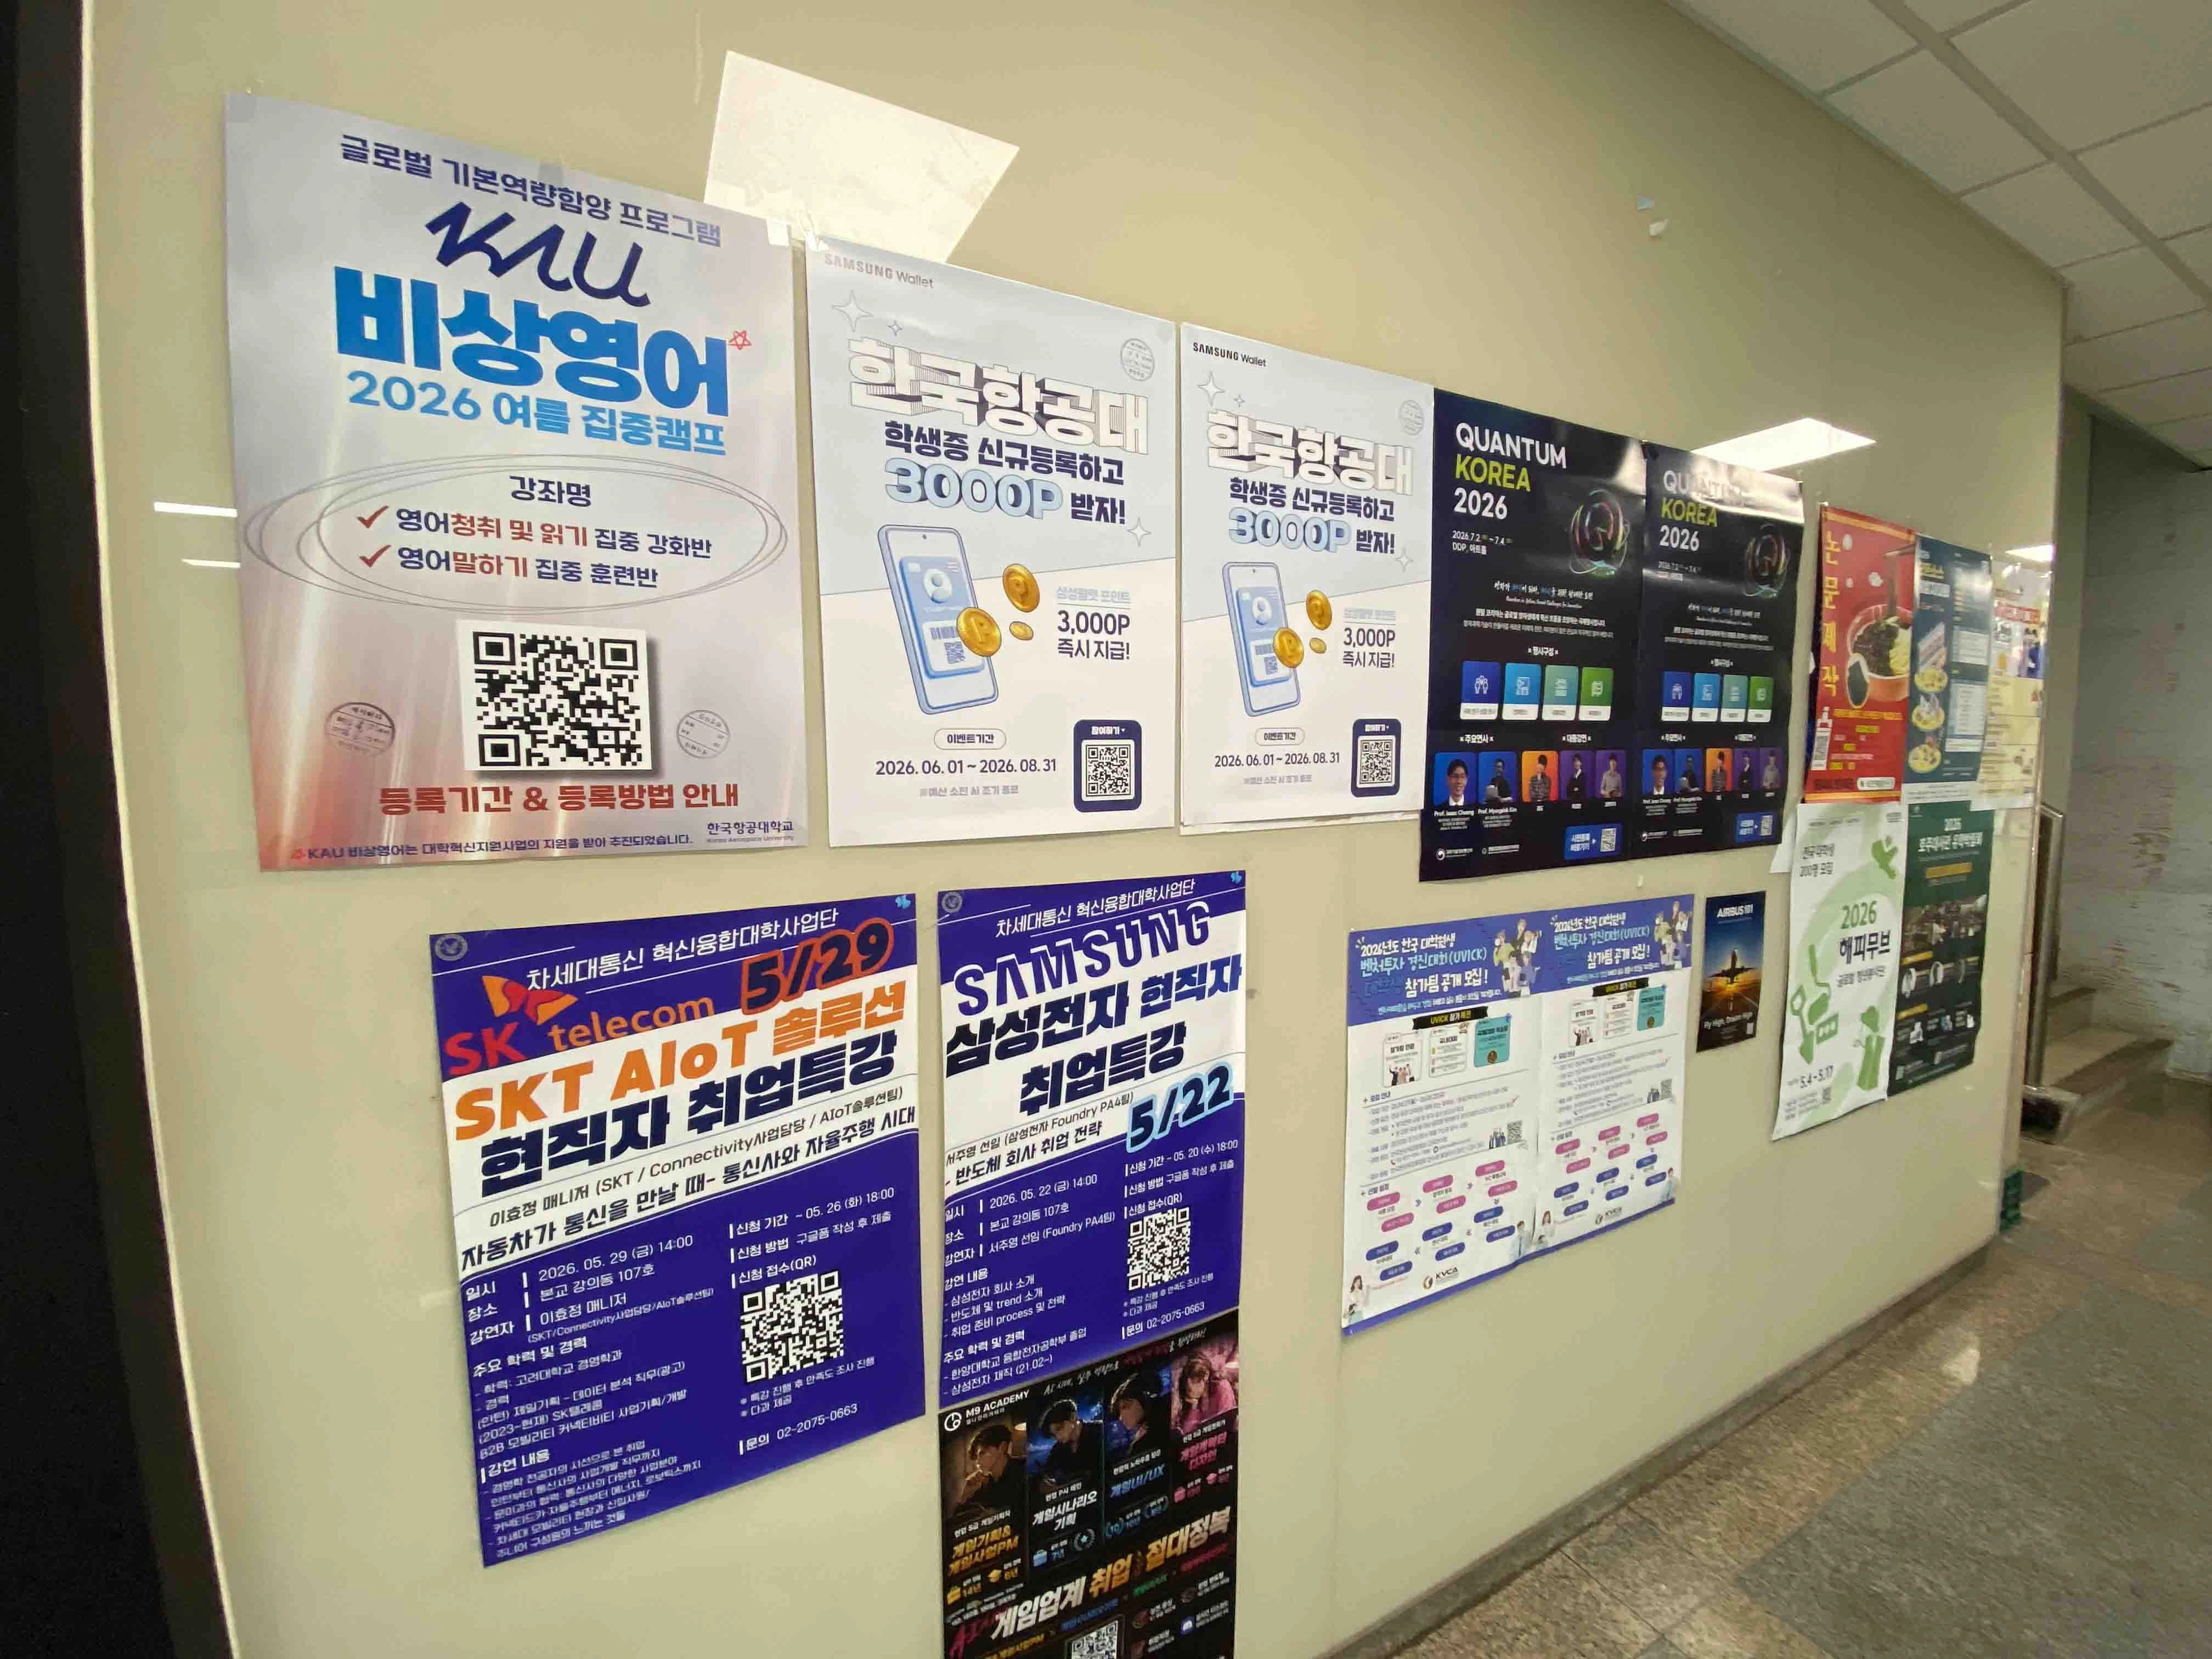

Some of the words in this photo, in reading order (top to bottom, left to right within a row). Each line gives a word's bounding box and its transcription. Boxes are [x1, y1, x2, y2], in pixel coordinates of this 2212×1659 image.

[341, 134, 432, 178] 글로벌
[442, 158, 611, 220] 기본역량함양
[619, 202, 721, 247] 프로그램
[896, 270, 934, 289] Wallet
[335, 266, 729, 416] 비상영어
[1193, 342, 1238, 360] SAMSUNG
[1241, 353, 1266, 368] Wallet
[348, 371, 481, 420] 2026
[493, 392, 571, 436] 여름
[582, 405, 726, 455] 집중캠프
[847, 337, 1148, 455] 한국항공대
[885, 421, 968, 461] 학생증
[978, 437, 1124, 486] 신규등록하고
[1207, 409, 1414, 495] 한국항공대
[1456, 422, 1567, 469] QUANTUM
[509, 476, 591, 507] 강좌명
[885, 458, 1063, 519] 3000P
[1071, 493, 1125, 524] 받자!
[1455, 453, 1531, 492] KOREA
[1230, 477, 1286, 508] 학생증
[1293, 487, 1395, 522] 신규등록하고
[1454, 487, 1508, 520] 2026
[1661, 499, 1718, 527] KOREA
[396, 508, 502, 539] 영어청취
[510, 520, 534, 541] 및
[541, 521, 588, 547] 읽기
[594, 528, 640, 552] 집중
[648, 532, 712, 559] 강화반
[1229, 507, 1351, 552] 3000P
[1356, 529, 1395, 554] 받자!
[1660, 525, 1700, 551] 2026
[398, 546, 528, 578] 영어말하기
[535, 558, 582, 582] 집중
[590, 562, 658, 589] 훈련반
[1058, 610, 1130, 636] 3,000P
[1344, 628, 1396, 647] 3,000P
[1058, 638, 1090, 659] 즉시
[1094, 640, 1130, 661] 지급!
[1343, 651, 1365, 668] 즉시
[1368, 653, 1395, 668] 지급!
[947, 733, 994, 744] 이벤트기간
[379, 785, 512, 814] 등록기간
[523, 785, 549, 811] &
[557, 783, 674, 811] 등록방법
[683, 782, 738, 809] 안내
[583, 838, 606, 848] 받아
[707, 821, 794, 836] 한국항공대학교
[996, 905, 1071, 938] 차세대통신
[1076, 878, 1196, 918] 혁신융합대학사업단
[1839, 900, 1878, 930] 2026
[527, 949, 644, 992] 차세대통신
[653, 907, 838, 962] 혁신융합대학사업단
[741, 918, 895, 1015] 5/29
[954, 901, 1210, 1016] SAMSUNG
[1838, 929, 1892, 966] 해피무브
[1405, 975, 1439, 998] 참가팀
[1442, 973, 1462, 991] 공개
[444, 1021, 526, 1076] SK
[548, 996, 715, 1052] telecom
[946, 981, 1129, 1078] 삼성전자
[1140, 953, 1242, 1018] 현직자
[456, 1061, 594, 1141] SKT
[610, 1022, 758, 1102] AIoT
[772, 979, 907, 1057] 솔루션
[1019, 1021, 1187, 1116] 취업특강
[481, 1096, 671, 1198] 현직자
[687, 1029, 898, 1133] 취업특강
[1126, 1061, 1234, 1153] 5/22
[946, 1148, 976, 1166] 서주영
[980, 1137, 1000, 1153] 선임
[1005, 1122, 1048, 1147] (삼성전자
[1052, 1106, 1098, 1130] Foundry
[956, 1156, 1001, 1186] 반도체
[1005, 1146, 1036, 1167] 회사
[1041, 1133, 1069, 1154] 취업
[1074, 1120, 1102, 1143] 전략
[461, 1223, 556, 1272] 자동차가
[563, 1197, 629, 1235] 통신을
[636, 1182, 679, 1210] 만날
[723, 1143, 800, 1184] 통신사와
[806, 1116, 876, 1158] 자율주행
[881, 1105, 916, 1131] 시대
[490, 1200, 537, 1227] 이효정
[543, 1183, 589, 1211] 매니저
[596, 1171, 633, 1197] (SKT
[736, 1220, 761, 1235] 신청
[764, 1214, 788, 1229] 기간
[827, 1201, 842, 1214] 26
[866, 1187, 895, 1203] 18:00
[1128, 1203, 1146, 1216] 신청
[465, 1280, 496, 1301] 일시
[610, 1250, 628, 1264] 29
[632, 1244, 654, 1260] (금)
[658, 1235, 693, 1252] 14:00
[739, 1268, 763, 1284] 신청
[766, 1255, 817, 1278] 접수(QR)
[467, 1304, 499, 1322] 장소
[540, 1284, 569, 1301] 본교
[573, 1272, 614, 1294] 강의동
[619, 1263, 656, 1282] 107호
[470, 1321, 515, 1345] 강연자
[540, 1303, 582, 1325] 이효정
[586, 1292, 628, 1313] 매니저
[777, 1403, 858, 1440] 02-2075-0663
[966, 1405, 981, 1417] M9
[983, 1390, 1030, 1412] ACADEMY
[488, 1458, 517, 1477] 강연
[521, 1448, 551, 1468] 내용
[991, 1575, 1087, 1640] 게임업계
